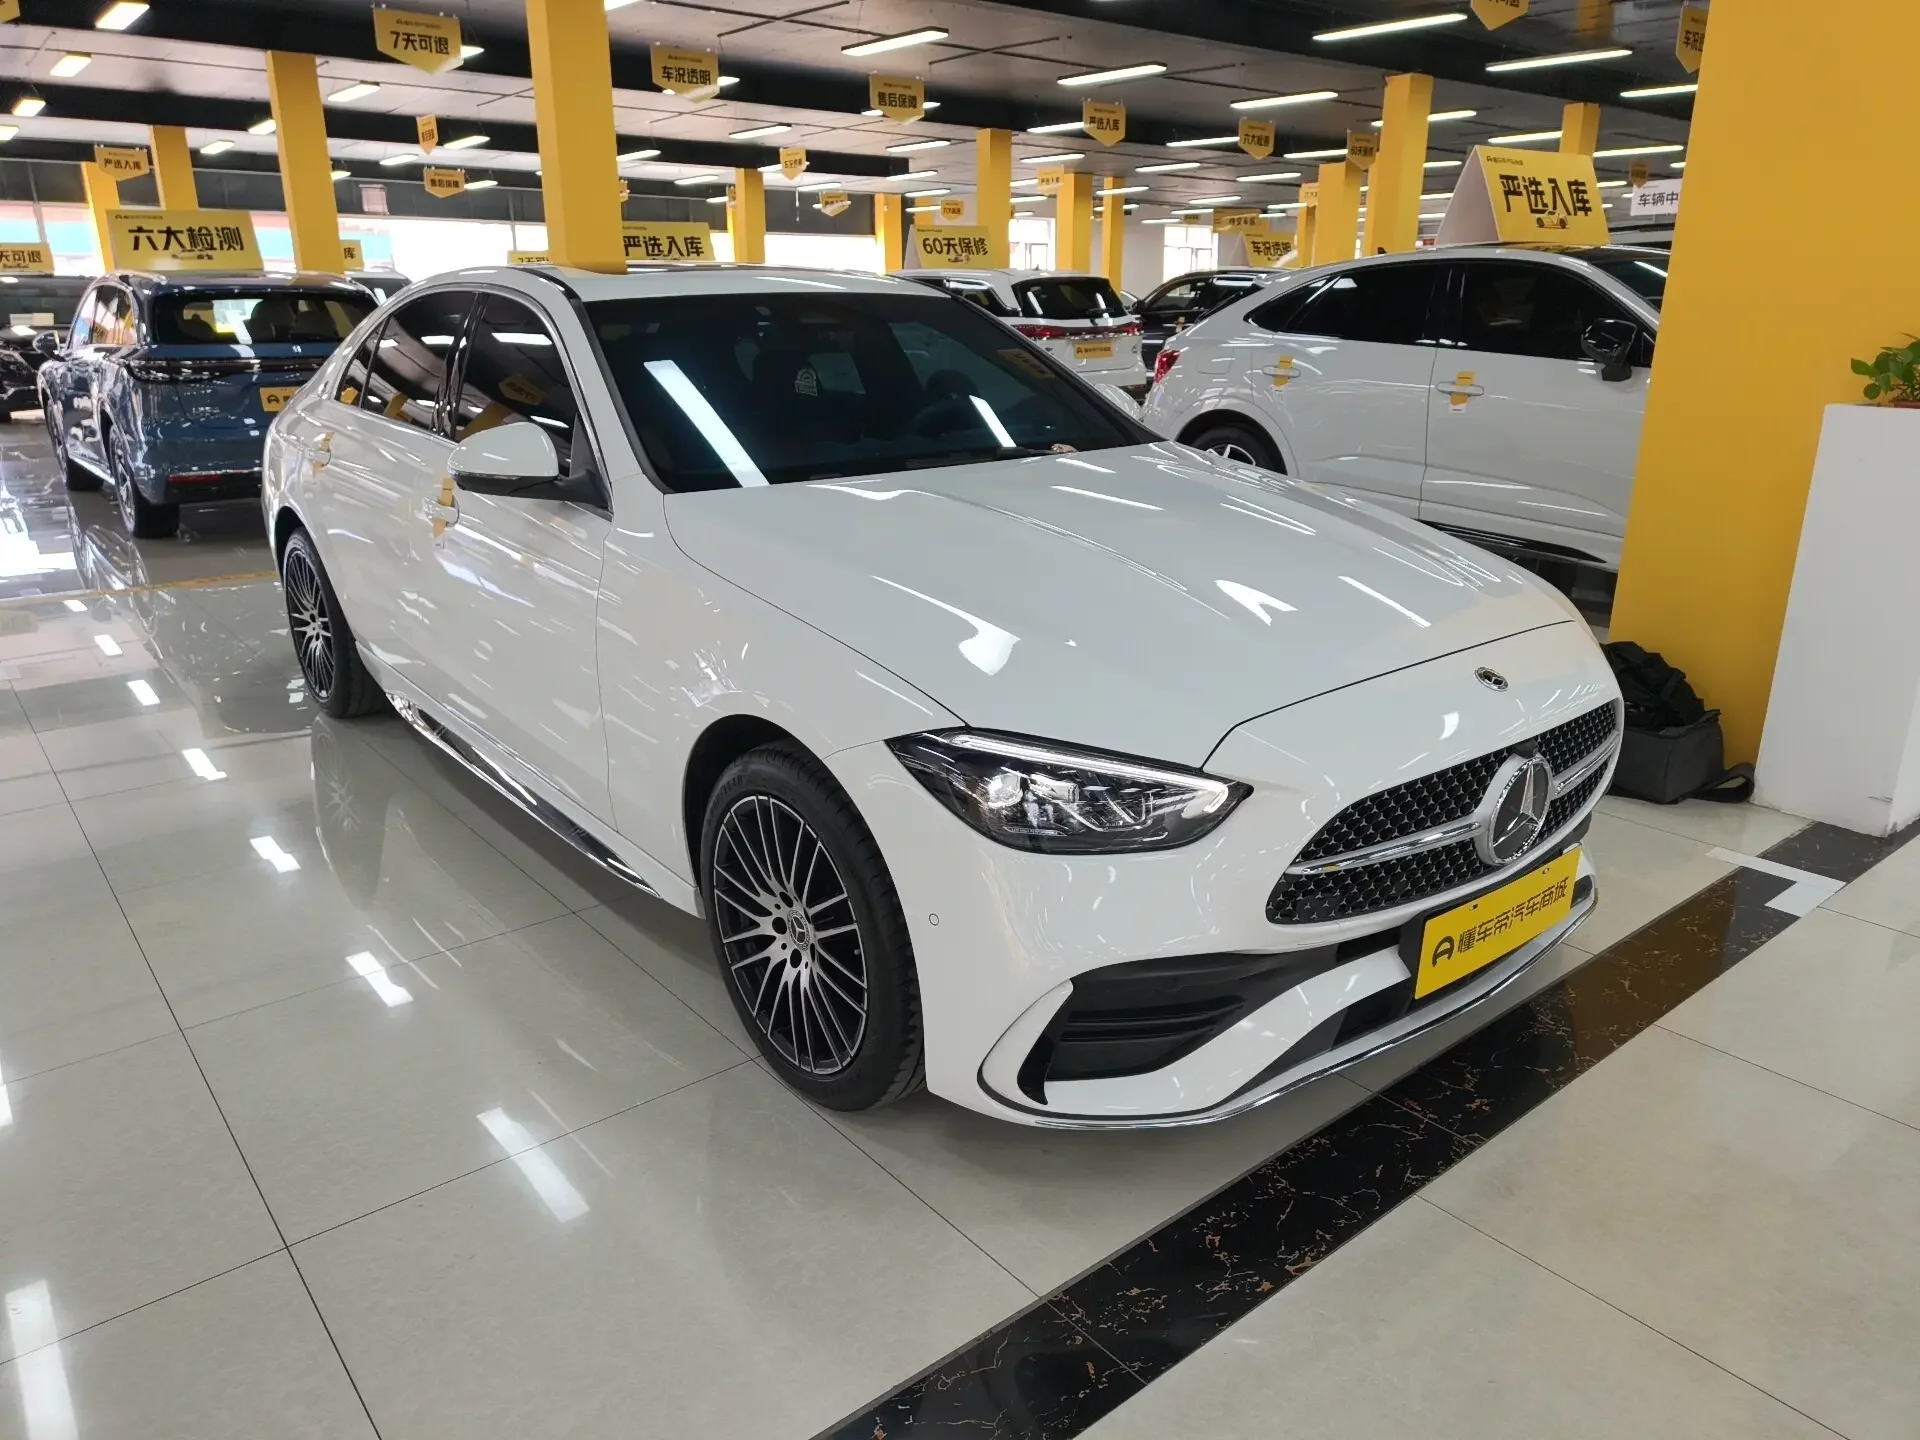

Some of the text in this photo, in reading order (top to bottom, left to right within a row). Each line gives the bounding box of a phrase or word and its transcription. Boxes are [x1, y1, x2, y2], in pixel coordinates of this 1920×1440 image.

[390, 30, 450, 55] 7天可退
[661, 65, 712, 86] 车况透明
[878, 91, 918, 109] 售后保障
[104, 157, 142, 171] 严选入库
[1498, 174, 1593, 217] 严选入库
[1637, 190, 1679, 208] 车辆中
[128, 225, 245, 252] 六大检测
[622, 235, 704, 257] 严选入库
[922, 237, 989, 256] 60天保修
[1251, 240, 1292, 257] 车况透明
[1457, 875, 1570, 954] 懂车帝汽车商城
